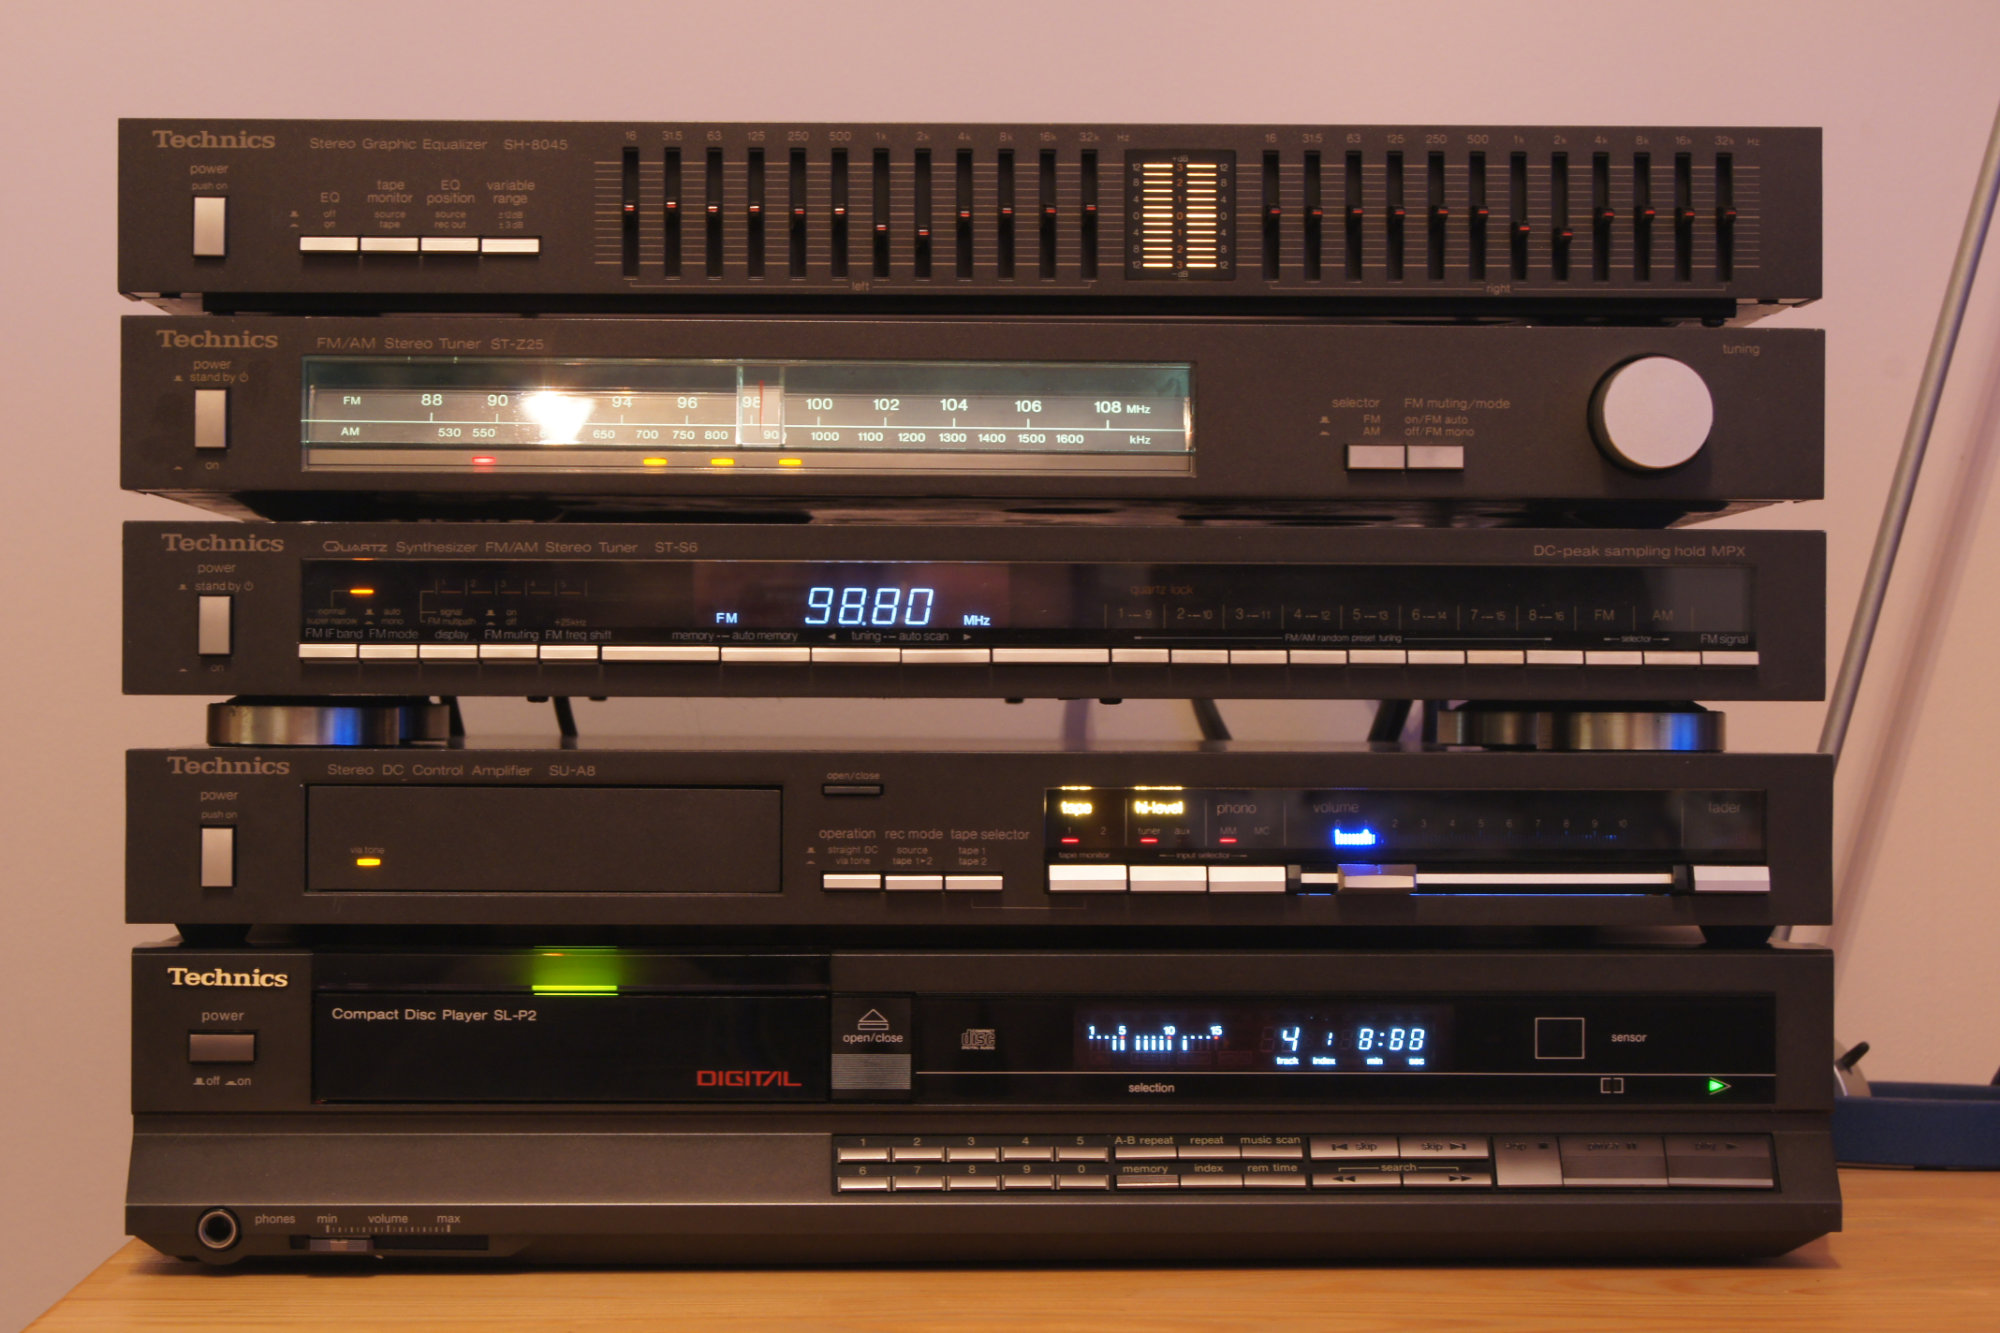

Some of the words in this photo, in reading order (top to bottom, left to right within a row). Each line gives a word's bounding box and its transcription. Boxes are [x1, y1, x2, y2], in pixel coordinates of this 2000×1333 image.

[152, 129, 275, 149] Technics
[707, 132, 722, 141] 63
[748, 132, 765, 141] 125
[788, 132, 809, 142] 250
[829, 132, 852, 142] 500
[1346, 134, 1360, 144] 63
[1387, 134, 1404, 144] 125
[1426, 134, 1447, 144] 250
[1467, 134, 1488, 144] 500
[309, 137, 356, 150] Stereo
[362, 137, 416, 153] Graphic
[423, 138, 487, 153] Equalizer
[504, 139, 568, 151] SH-8045
[190, 164, 229, 176] power
[377, 180, 405, 192] tape
[441, 179, 460, 191] EQ
[487, 180, 535, 191] variable
[320, 192, 340, 204] EQ
[367, 192, 412, 204] monitor
[426, 192, 475, 207] position
[493, 194, 527, 207] range
[1486, 283, 1511, 295] right
[156, 330, 278, 349] Technics
[317, 337, 376, 350] FM/AM
[384, 337, 433, 350] Stereo
[440, 337, 481, 350] Tuner
[490, 338, 544, 350] ST-Z25
[1722, 344, 1760, 356] tuning
[193, 359, 231, 372] power
[343, 396, 361, 405] FM
[421, 394, 443, 406] 88
[487, 395, 508, 406] 90
[612, 396, 632, 409] 94
[677, 397, 698, 409] 96
[742, 396, 760, 408] 98
[806, 398, 833, 410] 100
[873, 399, 900, 411] 102
[940, 399, 968, 411] 104
[1015, 400, 1042, 412] 106
[1094, 401, 1121, 413] 108
[1126, 405, 1151, 414] MHz
[1331, 397, 1380, 408] selector
[1404, 398, 1423, 408] FM
[1426, 397, 1510, 411] muting/mode
[1363, 415, 1381, 424] FM
[1404, 414, 1442, 425] on/FM
[1445, 415, 1468, 425] auto
[341, 427, 360, 436] AM
[438, 428, 461, 437] 530
[472, 429, 495, 438] 550
[593, 430, 615, 439] 650
[636, 430, 659, 440] 700
[672, 430, 695, 440] 750
[704, 431, 728, 440] 800
[811, 432, 840, 441] 1000
[857, 432, 883, 442] 1100
[897, 433, 926, 442] 1200
[939, 433, 967, 443] 1300
[978, 434, 1006, 443] 1400
[1018, 434, 1046, 443] 1500
[1056, 434, 1084, 444] 1600
[1129, 435, 1151, 445] kHz
[1363, 427, 1380, 436] AM
[1404, 427, 1442, 437] off/FM
[1445, 428, 1475, 437] mono
[205, 461, 219, 470] on
[161, 533, 285, 552] Technics
[323, 541, 388, 553] QUARTZ
[396, 542, 478, 555] Synthesizer
[485, 542, 538, 553] FM/AM
[545, 542, 591, 553] Stereo
[599, 542, 638, 553] Tuner
[655, 542, 698, 553] ST-S6
[1533, 545, 1599, 558] DC-peak
[1604, 545, 1671, 560] sampling
[1674, 545, 1705, 558] hold
[1711, 546, 1746, 557] MPX
[197, 564, 237, 575] power
[195, 582, 226, 592] stand
[228, 582, 242, 593] by
[716, 613, 738, 624] FM
[963, 615, 991, 626] MHz
[1594, 609, 1615, 621] FM
[1652, 610, 1673, 621] AM
[369, 629, 385, 639] FM
[387, 629, 419, 639] mode
[435, 629, 469, 641] display
[484, 629, 502, 639] FM
[503, 629, 539, 642] muting
[545, 629, 562, 639] FM
[565, 629, 587, 642] freq
[590, 629, 612, 639] shift
[672, 632, 715, 643] memory
[732, 632, 753, 642] auto
[755, 632, 799, 643] memory
[851, 632, 881, 644] tuning
[898, 632, 920, 642] auto
[922, 633, 949, 642] scan
[1700, 634, 1717, 645] FM
[1719, 634, 1749, 647] signal
[210, 664, 224, 672] on
[167, 756, 291, 775] Technics
[327, 764, 374, 776] Stereo
[382, 764, 404, 776] DC
[412, 764, 463, 776] Control
[471, 764, 533, 778] Amplifier
[549, 765, 596, 777] SU-A8
[827, 771, 881, 782] open/close
[200, 791, 239, 804] power
[1217, 802, 1257, 815] phono
[1313, 803, 1359, 814] volume
[201, 810, 221, 820] push
[224, 811, 238, 819] on
[819, 829, 876, 841] operation
[885, 831, 906, 840] rec
[908, 829, 943, 840] mode
[950, 829, 978, 842] tape
[981, 829, 1030, 840] selector
[167, 968, 289, 988] Technics
[201, 1010, 245, 1024] power
[332, 1008, 399, 1024] Compact
[404, 1008, 437, 1022] Disc
[442, 1009, 487, 1025] Player
[494, 1009, 537, 1022] SL-P2
[1118, 1026, 1127, 1035] 5
[1163, 1025, 1175, 1035] 10
[1210, 1025, 1223, 1035] 15
[843, 1032, 903, 1045] open/close
[1282, 1027, 1300, 1051] 4
[1611, 1033, 1648, 1043] sensor
[206, 1076, 220, 1086] off
[237, 1078, 251, 1086] on
[696, 1070, 803, 1087] DIGITAL
[1128, 1082, 1175, 1094] selection
[913, 1137, 921, 1146] 2
[968, 1137, 975, 1146] 3
[1022, 1137, 1029, 1145] 4
[1077, 1137, 1084, 1145] 5
[1114, 1136, 1136, 1145] A-B
[1140, 1136, 1174, 1146] repeat
[1189, 1136, 1224, 1146] repeat
[1240, 1135, 1273, 1145] music
[1275, 1137, 1301, 1145] scan
[914, 1166, 920, 1174] 7
[968, 1165, 976, 1174] 8
[1023, 1165, 1031, 1174] 9
[1078, 1165, 1085, 1174] 0
[1122, 1165, 1169, 1175] memory
[1194, 1164, 1224, 1173] index
[1247, 1164, 1269, 1172] rem
[1273, 1164, 1298, 1172] time
[1381, 1163, 1417, 1172] search
[255, 1214, 296, 1226] phones
[317, 1214, 338, 1224] min
[368, 1214, 409, 1224] volume
[437, 1215, 461, 1224] max
